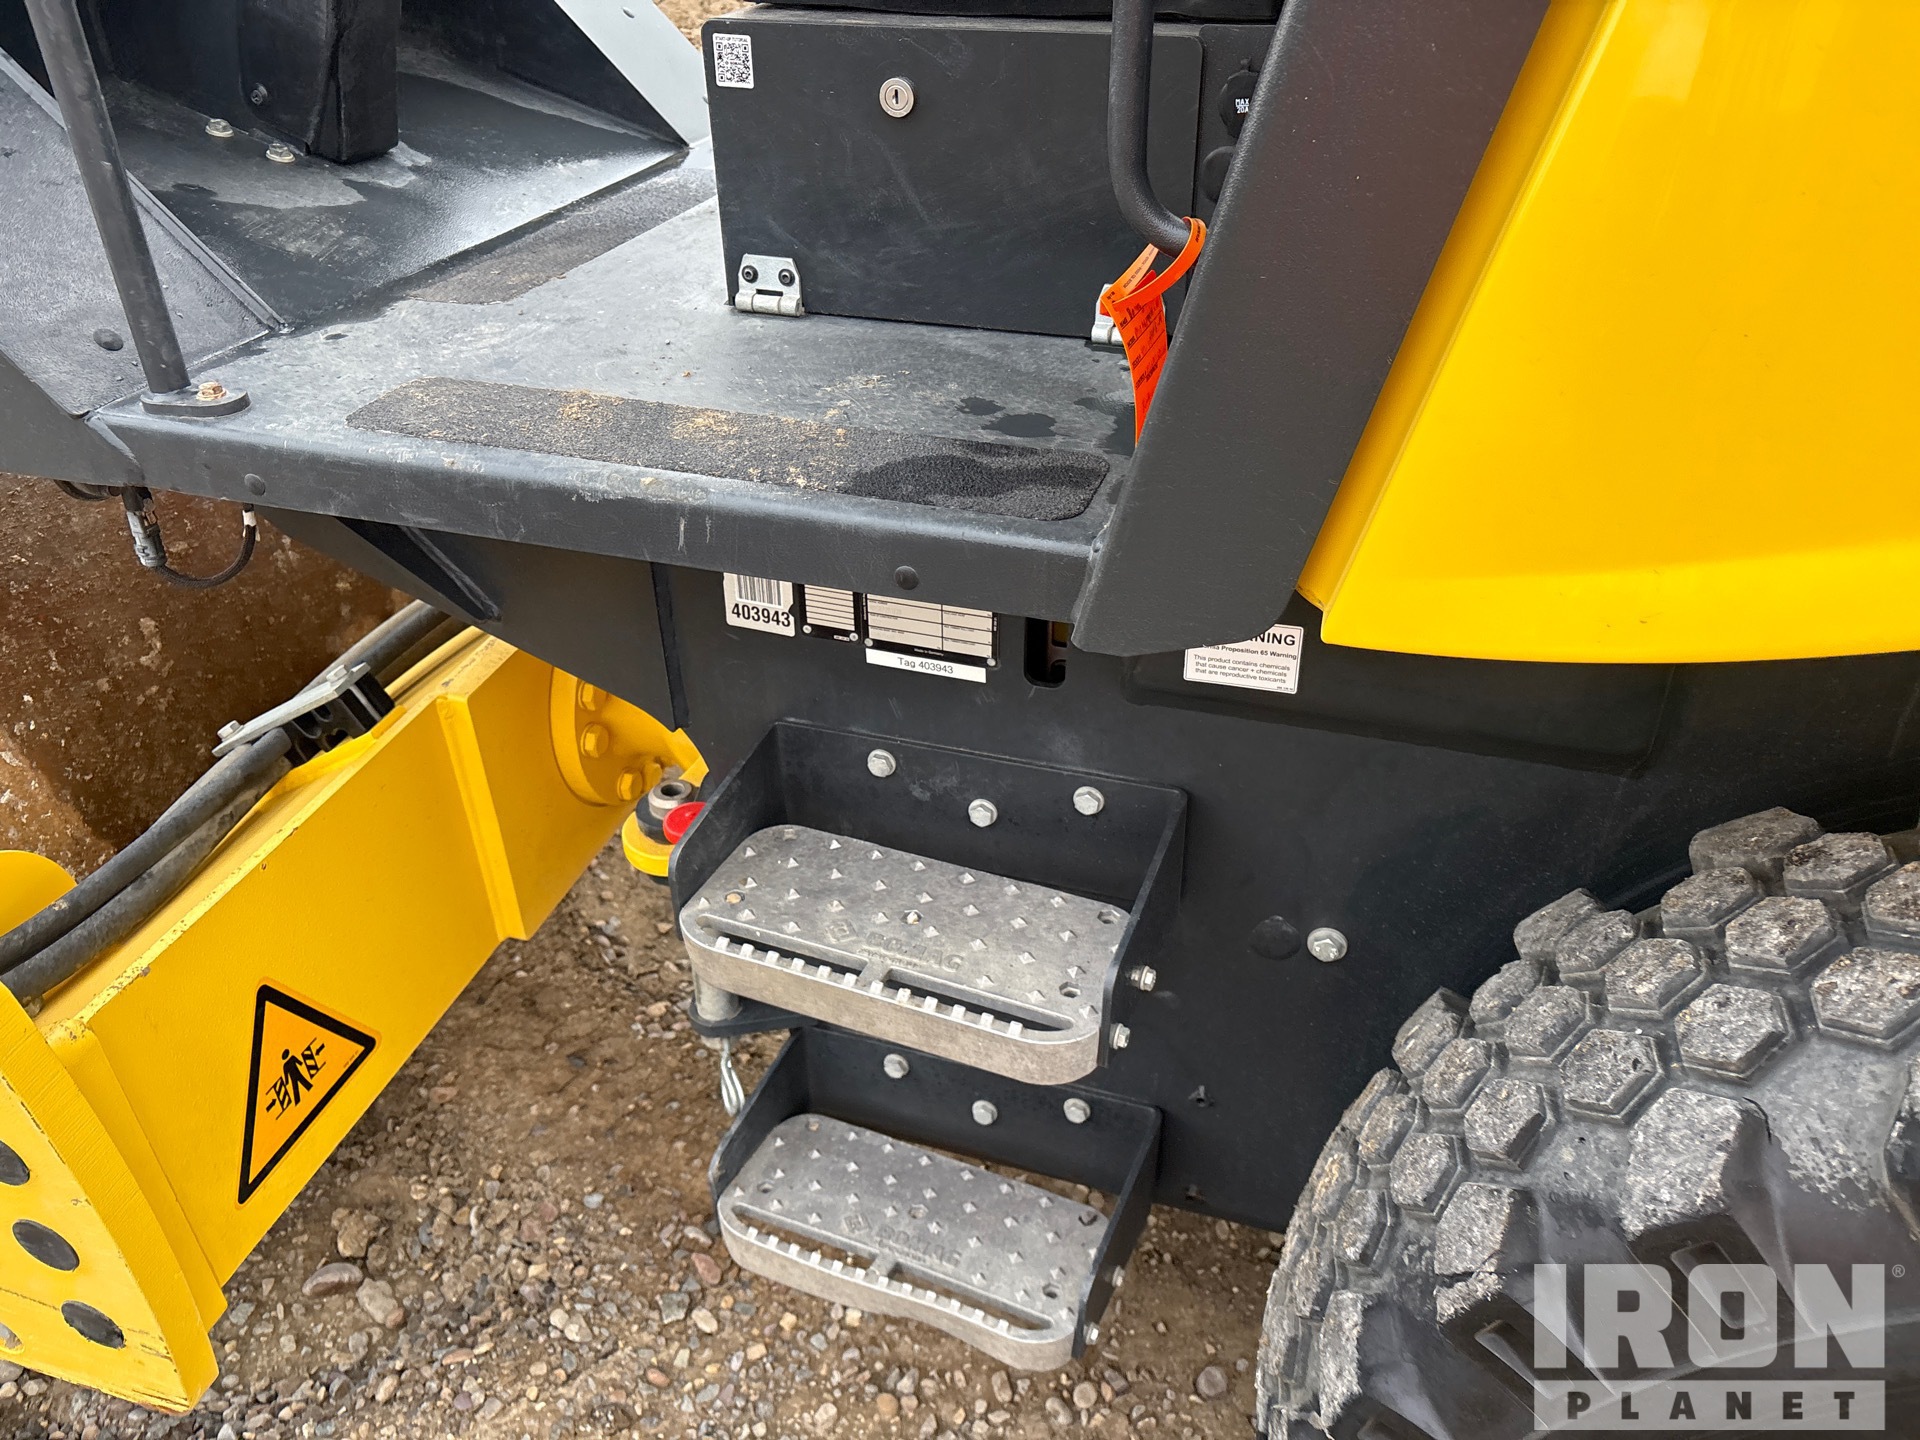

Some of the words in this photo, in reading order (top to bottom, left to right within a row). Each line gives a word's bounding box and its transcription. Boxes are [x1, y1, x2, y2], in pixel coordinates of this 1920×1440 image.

[1235, 98, 1249, 106] MAX
[732, 603, 790, 627] 403943
[1250, 632, 1296, 646] NING
[1221, 646, 1259, 655] Proposition
[1269, 651, 1297, 660] Warning
[897, 657, 916, 668] Tag
[918, 661, 954, 674] 403943
[1259, 663, 1291, 671] chemicals
[1219, 671, 1258, 679] reproductive
[1256, 669, 1287, 677] chemicals
